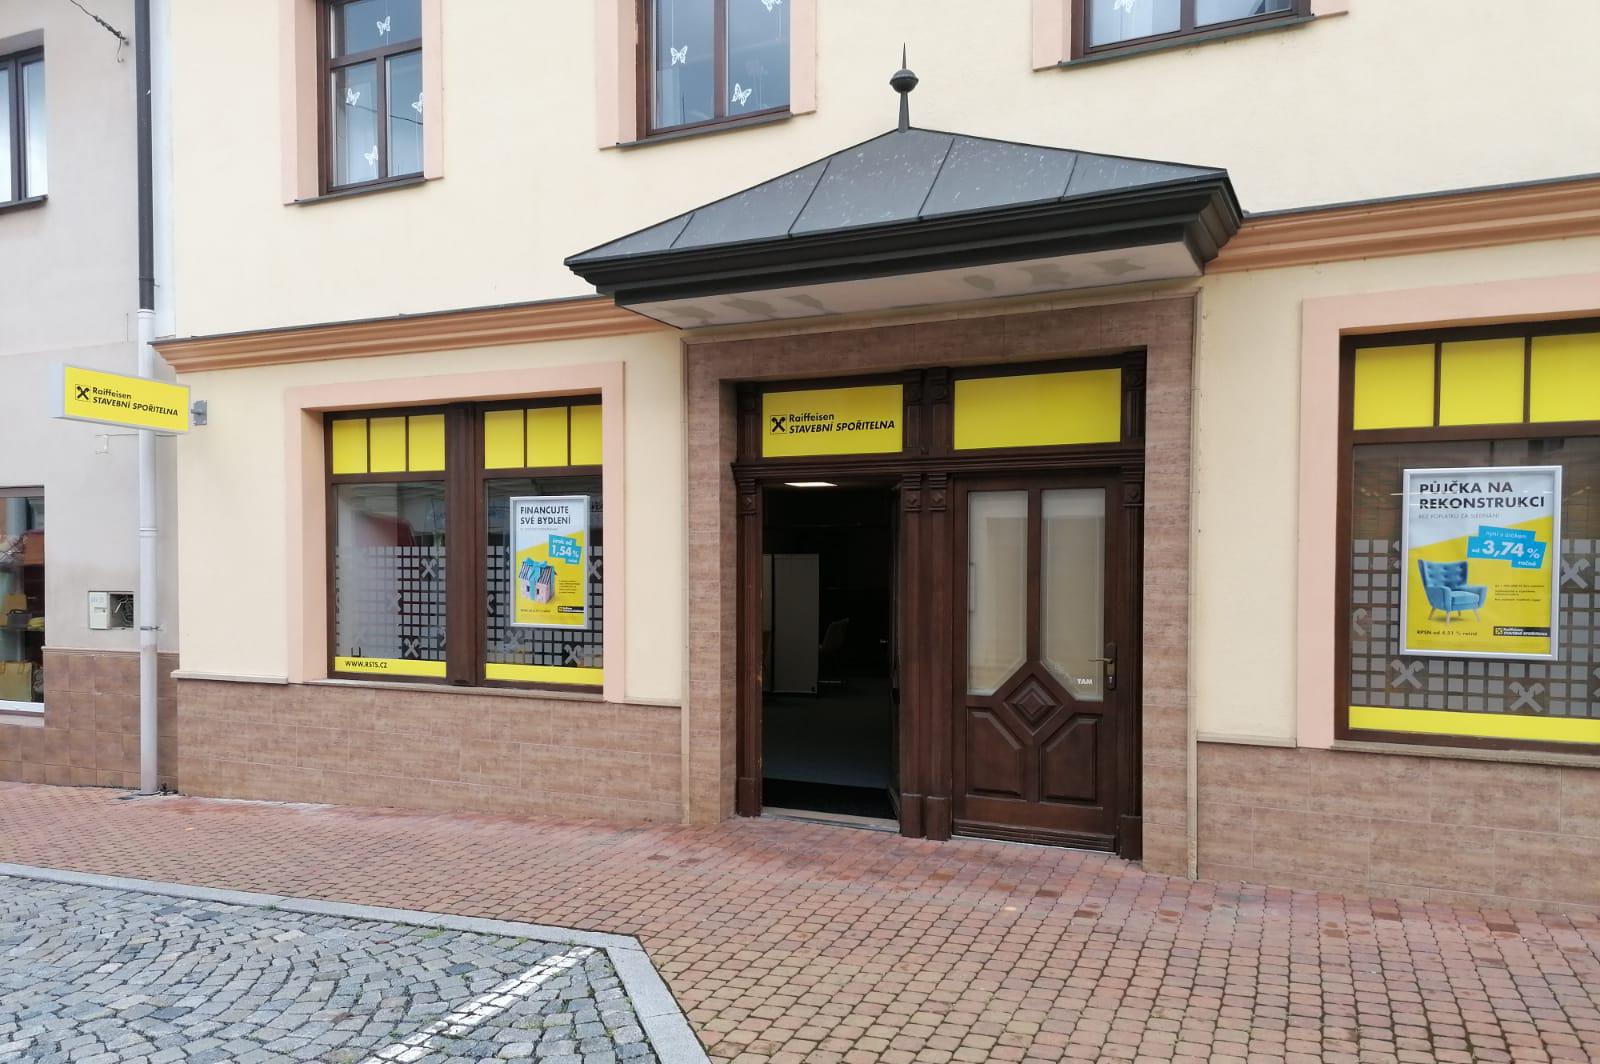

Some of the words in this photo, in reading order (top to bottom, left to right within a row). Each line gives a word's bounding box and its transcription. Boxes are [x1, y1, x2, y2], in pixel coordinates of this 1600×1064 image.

[92, 386, 132, 400] Raiffeisen
[92, 396, 131, 409] STAVEBNÍ
[132, 402, 178, 416] SPOŘITELNA
[789, 413, 834, 423] Raiffeisen
[789, 421, 833, 433] STAVEBNÍ
[836, 419, 895, 432] SPOŘITELNA
[1488, 482, 1513, 493] NA
[1419, 496, 1544, 509] REKONSTRUKCI
[520, 505, 569, 514] FINANCUJTE
[520, 515, 535, 525] SVÉ
[537, 515, 571, 525] BYDLENÍ
[552, 544, 572, 557] 1,54
[1482, 540, 1524, 557] 3,74
[1527, 548, 1540, 559] %
